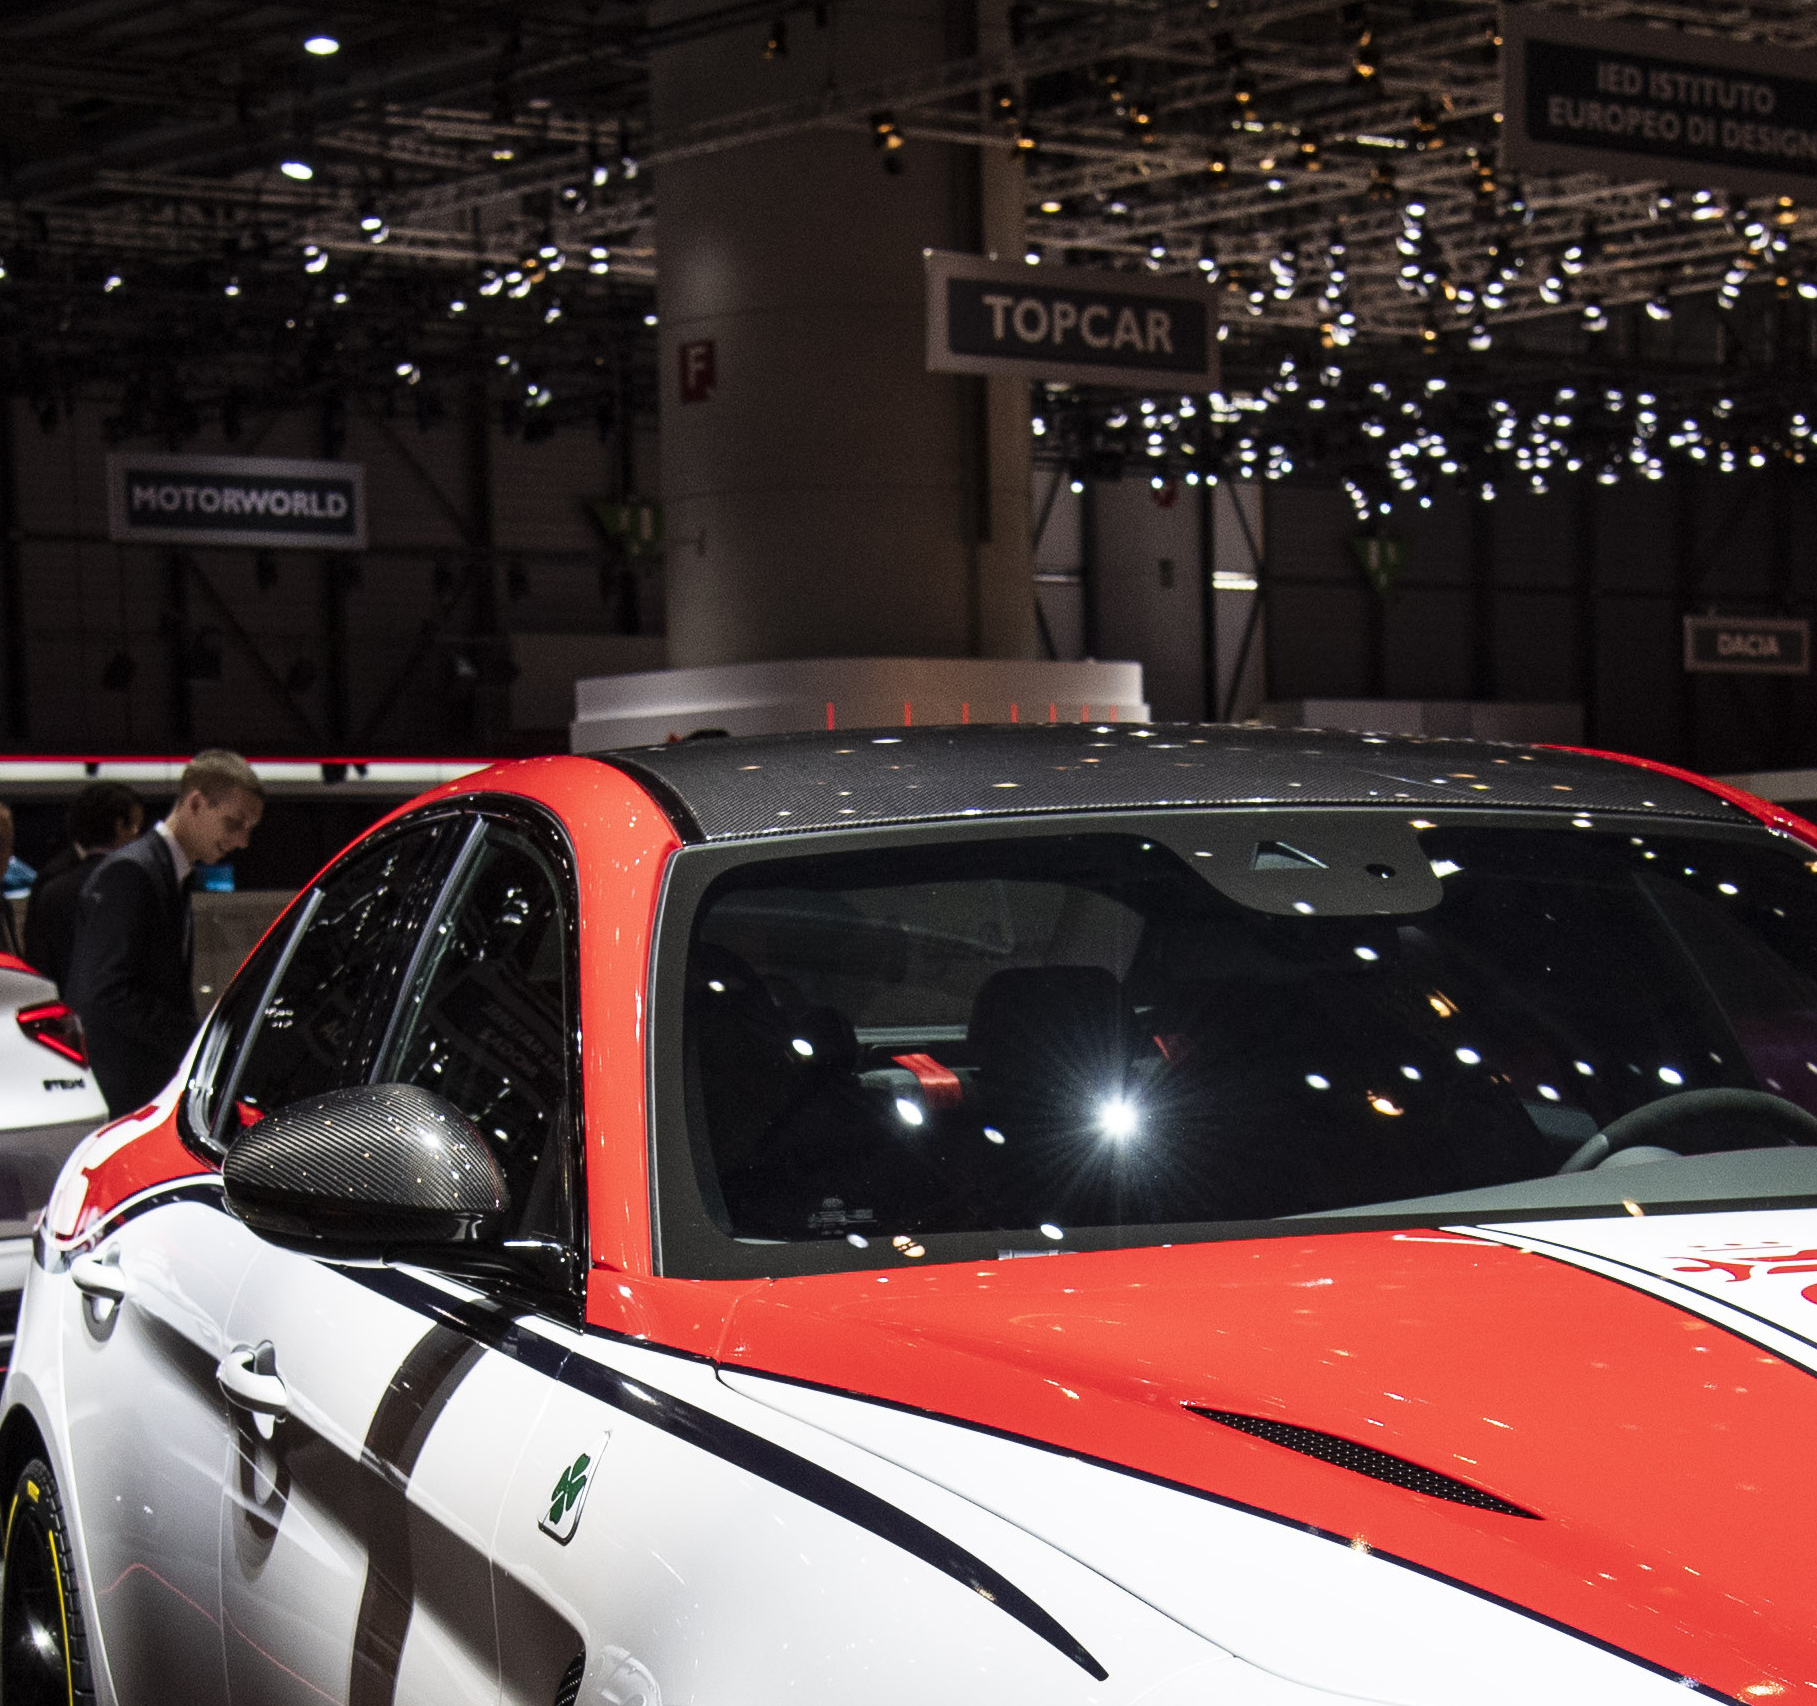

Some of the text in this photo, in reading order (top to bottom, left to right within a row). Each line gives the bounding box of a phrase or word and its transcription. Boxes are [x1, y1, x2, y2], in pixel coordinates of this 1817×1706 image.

[1597, 60, 1775, 116] IED ISTITUTO
[1548, 94, 1681, 142] EUROPEO
[1685, 113, 1718, 148] DI
[981, 294, 1174, 355] TOPCAR
[131, 484, 349, 521] MOTORWORLD
[1716, 631, 1780, 657] DACIA
